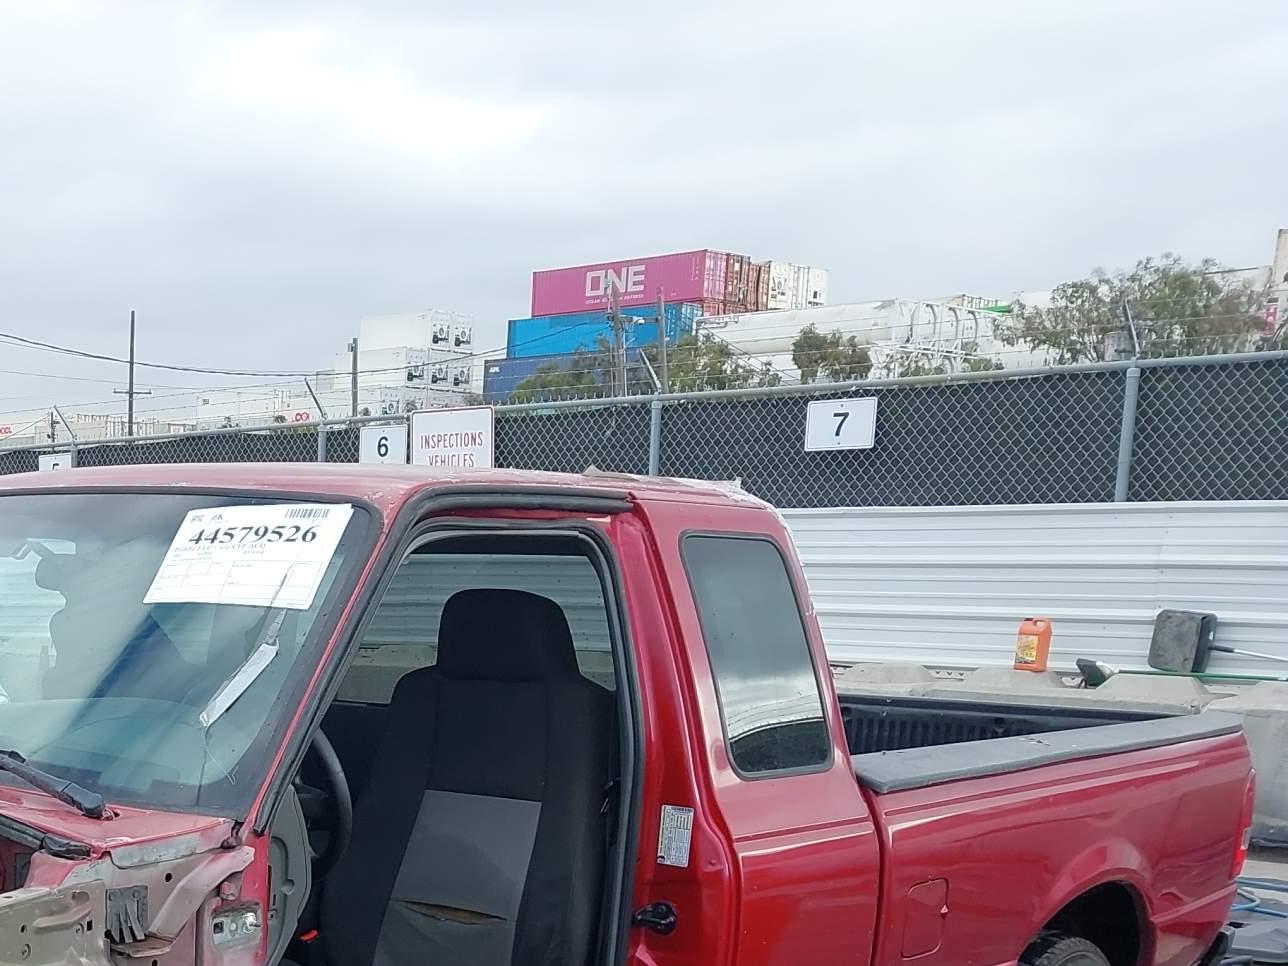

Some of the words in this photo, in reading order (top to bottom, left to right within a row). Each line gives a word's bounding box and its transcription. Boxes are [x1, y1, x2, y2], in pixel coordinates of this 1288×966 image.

[585, 265, 645, 296] ONE
[833, 411, 850, 437] 7
[377, 436, 389, 457] 6
[420, 431, 483, 449] INSPECTIONS
[428, 453, 474, 467] VEHICLES
[189, 525, 320, 545] 44579526
